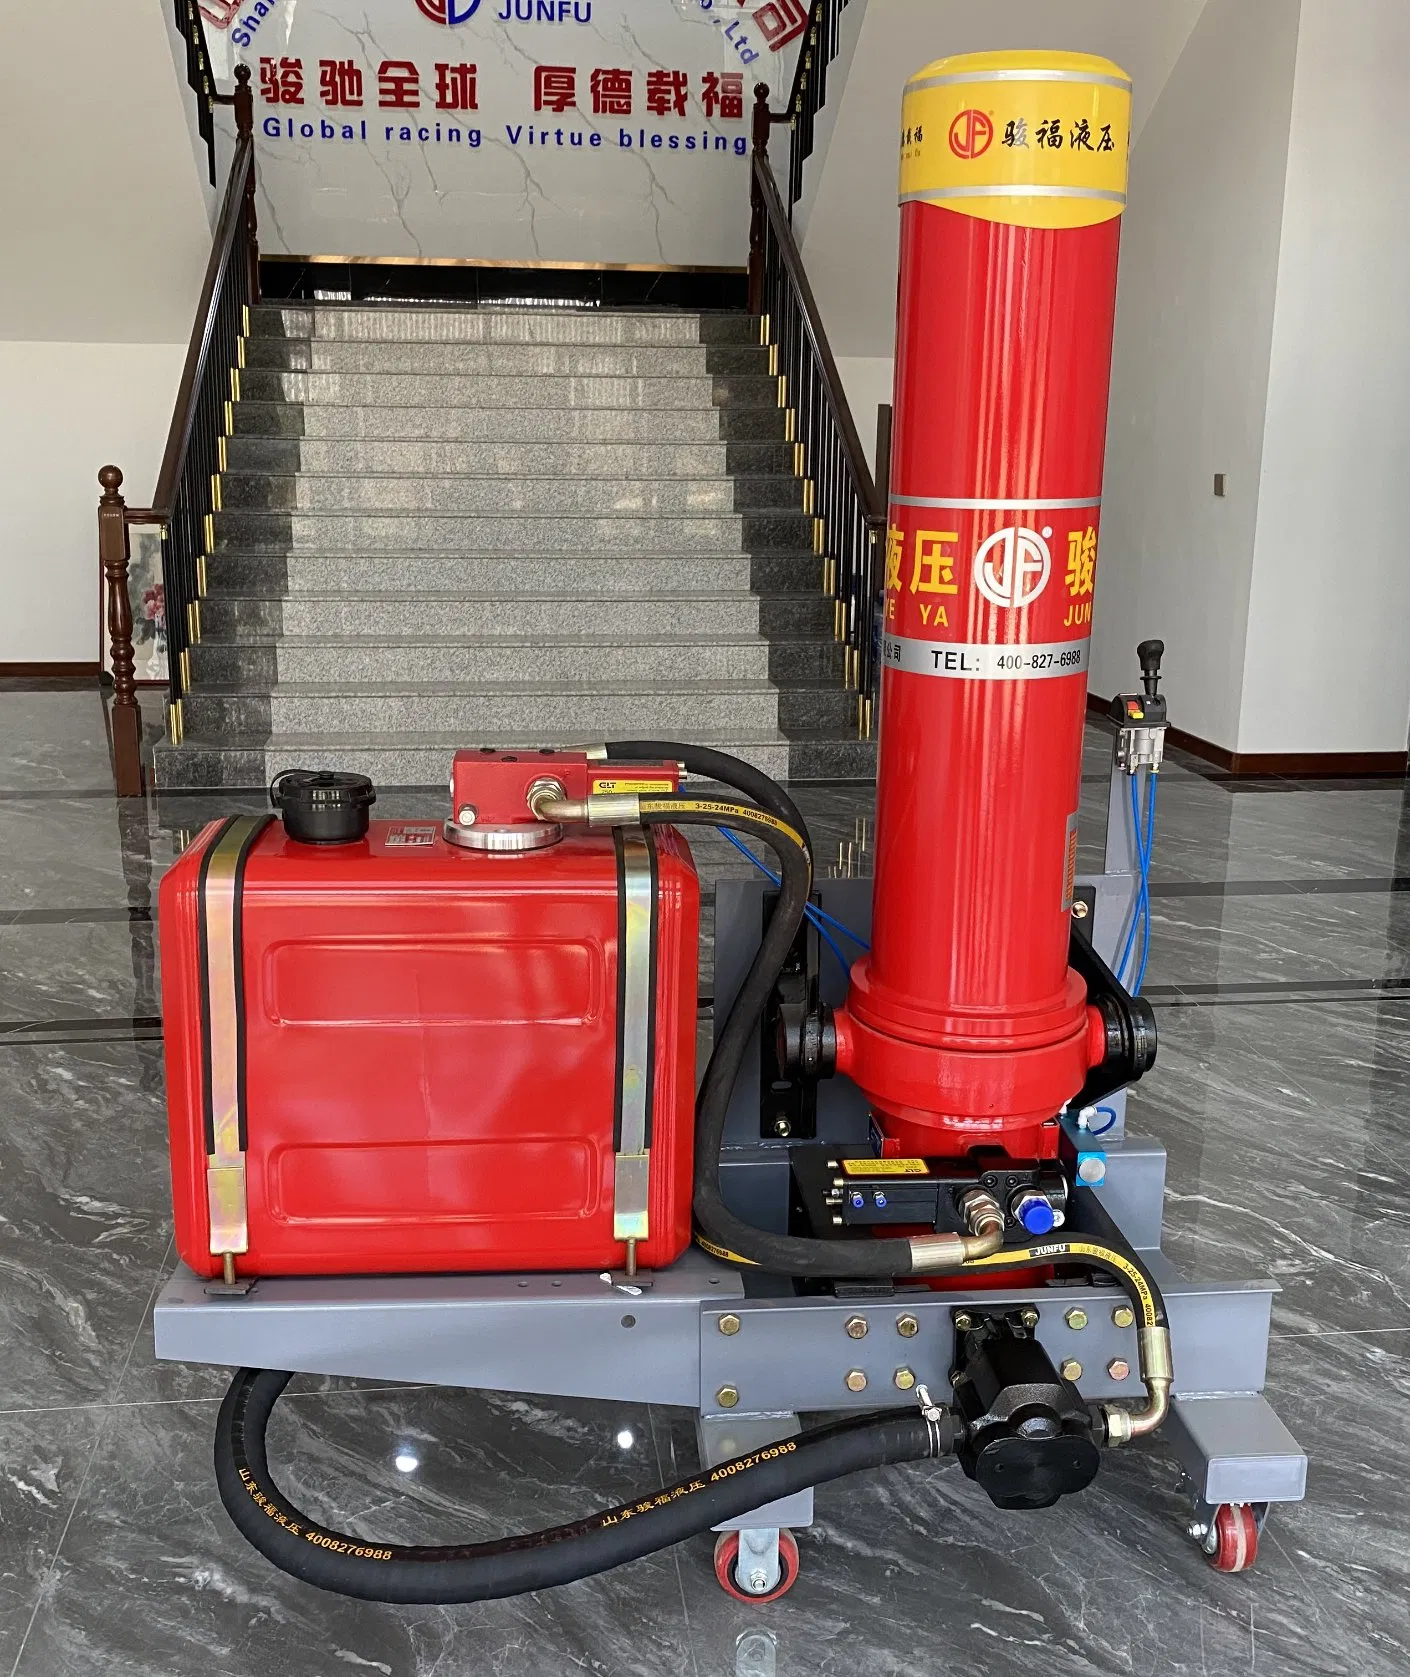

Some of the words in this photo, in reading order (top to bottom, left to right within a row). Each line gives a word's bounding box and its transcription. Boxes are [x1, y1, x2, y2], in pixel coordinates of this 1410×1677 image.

[498, 0, 592, 23] JUNFU
[259, 56, 479, 110] 骏驰全球
[533, 65, 744, 118] 厚德载福
[262, 117, 367, 140] Global
[384, 122, 482, 148] racing
[505, 125, 602, 147] Virtue
[618, 128, 747, 156] blessing
[1001, 117, 1115, 152] 骏福液压
[919, 603, 949, 628] YA
[930, 649, 981, 672] TEL:
[996, 649, 1081, 671] 400-827-6988
[695, 802, 739, 814] 3-25-24MPa
[1034, 1243, 1066, 1256] JUNFU
[1122, 1262, 1148, 1300] 3-25-24MPa
[709, 1441, 798, 1483] 4008276988
[238, 1467, 303, 1537] 山东骏福液压
[601, 1479, 706, 1528] 山东骏福液压
[304, 1530, 393, 1561] 4008276988
